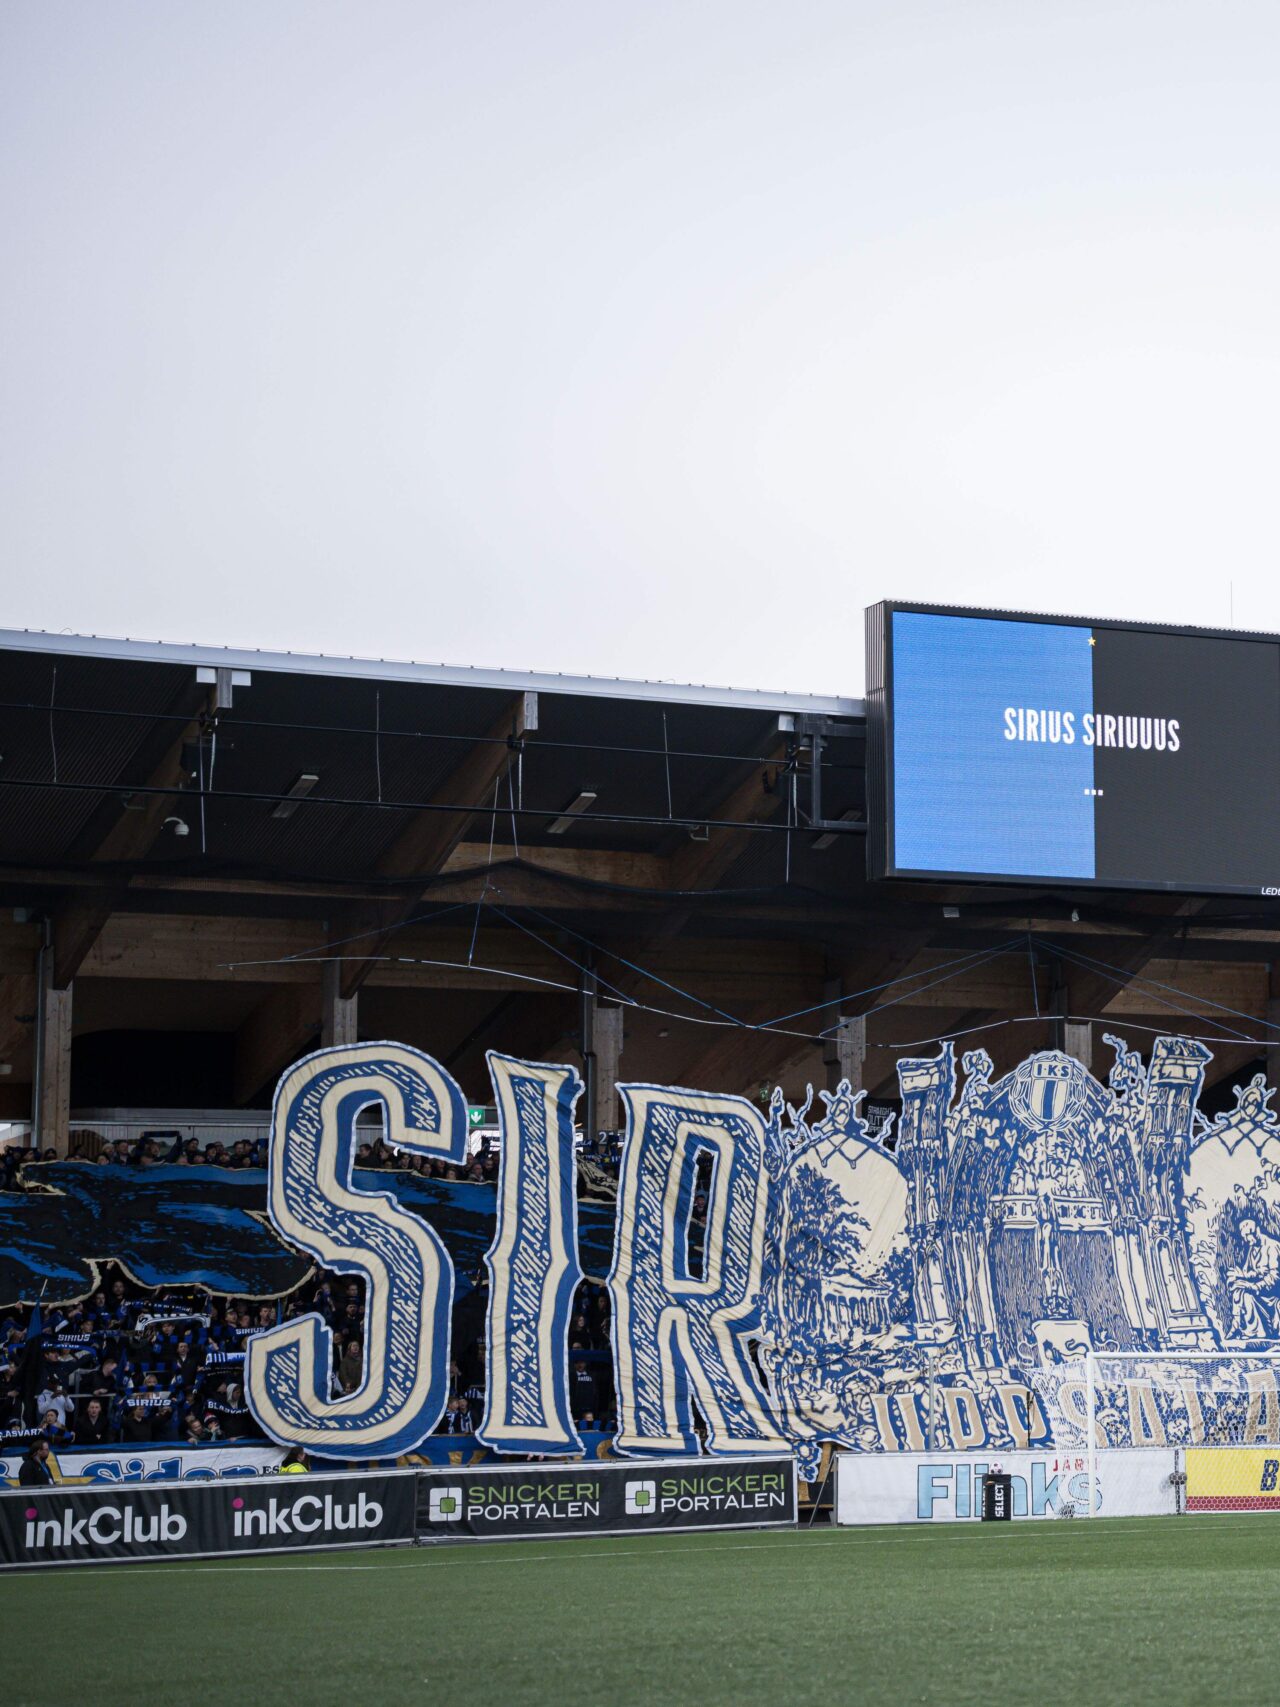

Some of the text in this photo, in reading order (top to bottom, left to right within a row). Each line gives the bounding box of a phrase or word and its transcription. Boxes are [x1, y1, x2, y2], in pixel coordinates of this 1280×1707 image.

[1003, 707, 1181, 752] SIRIUS SIRIUUUS
[57, 1333, 91, 1343] SIRIUS
[235, 1326, 266, 1336] SIRIUS
[126, 1399, 172, 1408] SIRIUS
[468, 1482, 600, 1504] SNICKERI
[661, 1474, 785, 1498] SNICKERI
[467, 1501, 600, 1522] PORTALEN
[660, 1491, 785, 1514] PORTALEN
[994, 1484, 1005, 1518] SELECT
[25, 1504, 187, 1548] inkClub
[232, 1492, 383, 1537] inkClub
